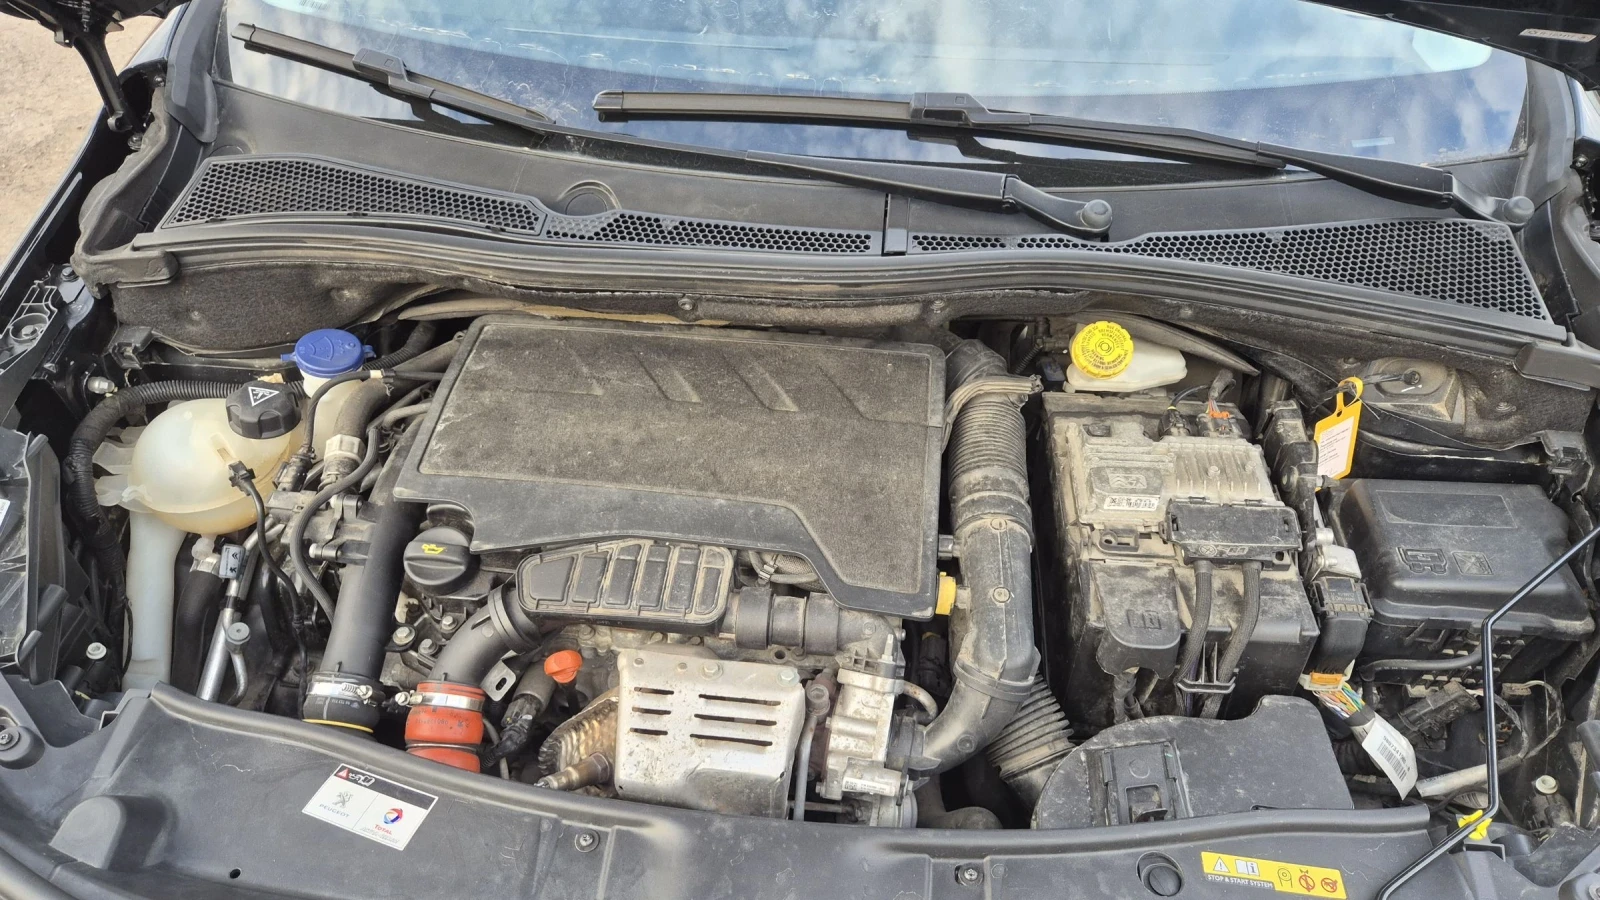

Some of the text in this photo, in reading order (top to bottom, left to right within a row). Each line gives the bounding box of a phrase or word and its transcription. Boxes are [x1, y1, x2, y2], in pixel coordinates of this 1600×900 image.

[319, 803, 350, 818] PEUGEOT
[374, 824, 392, 835] TOTAL
[1229, 877, 1249, 885] START
[1249, 880, 1274, 888] SYSTEM
